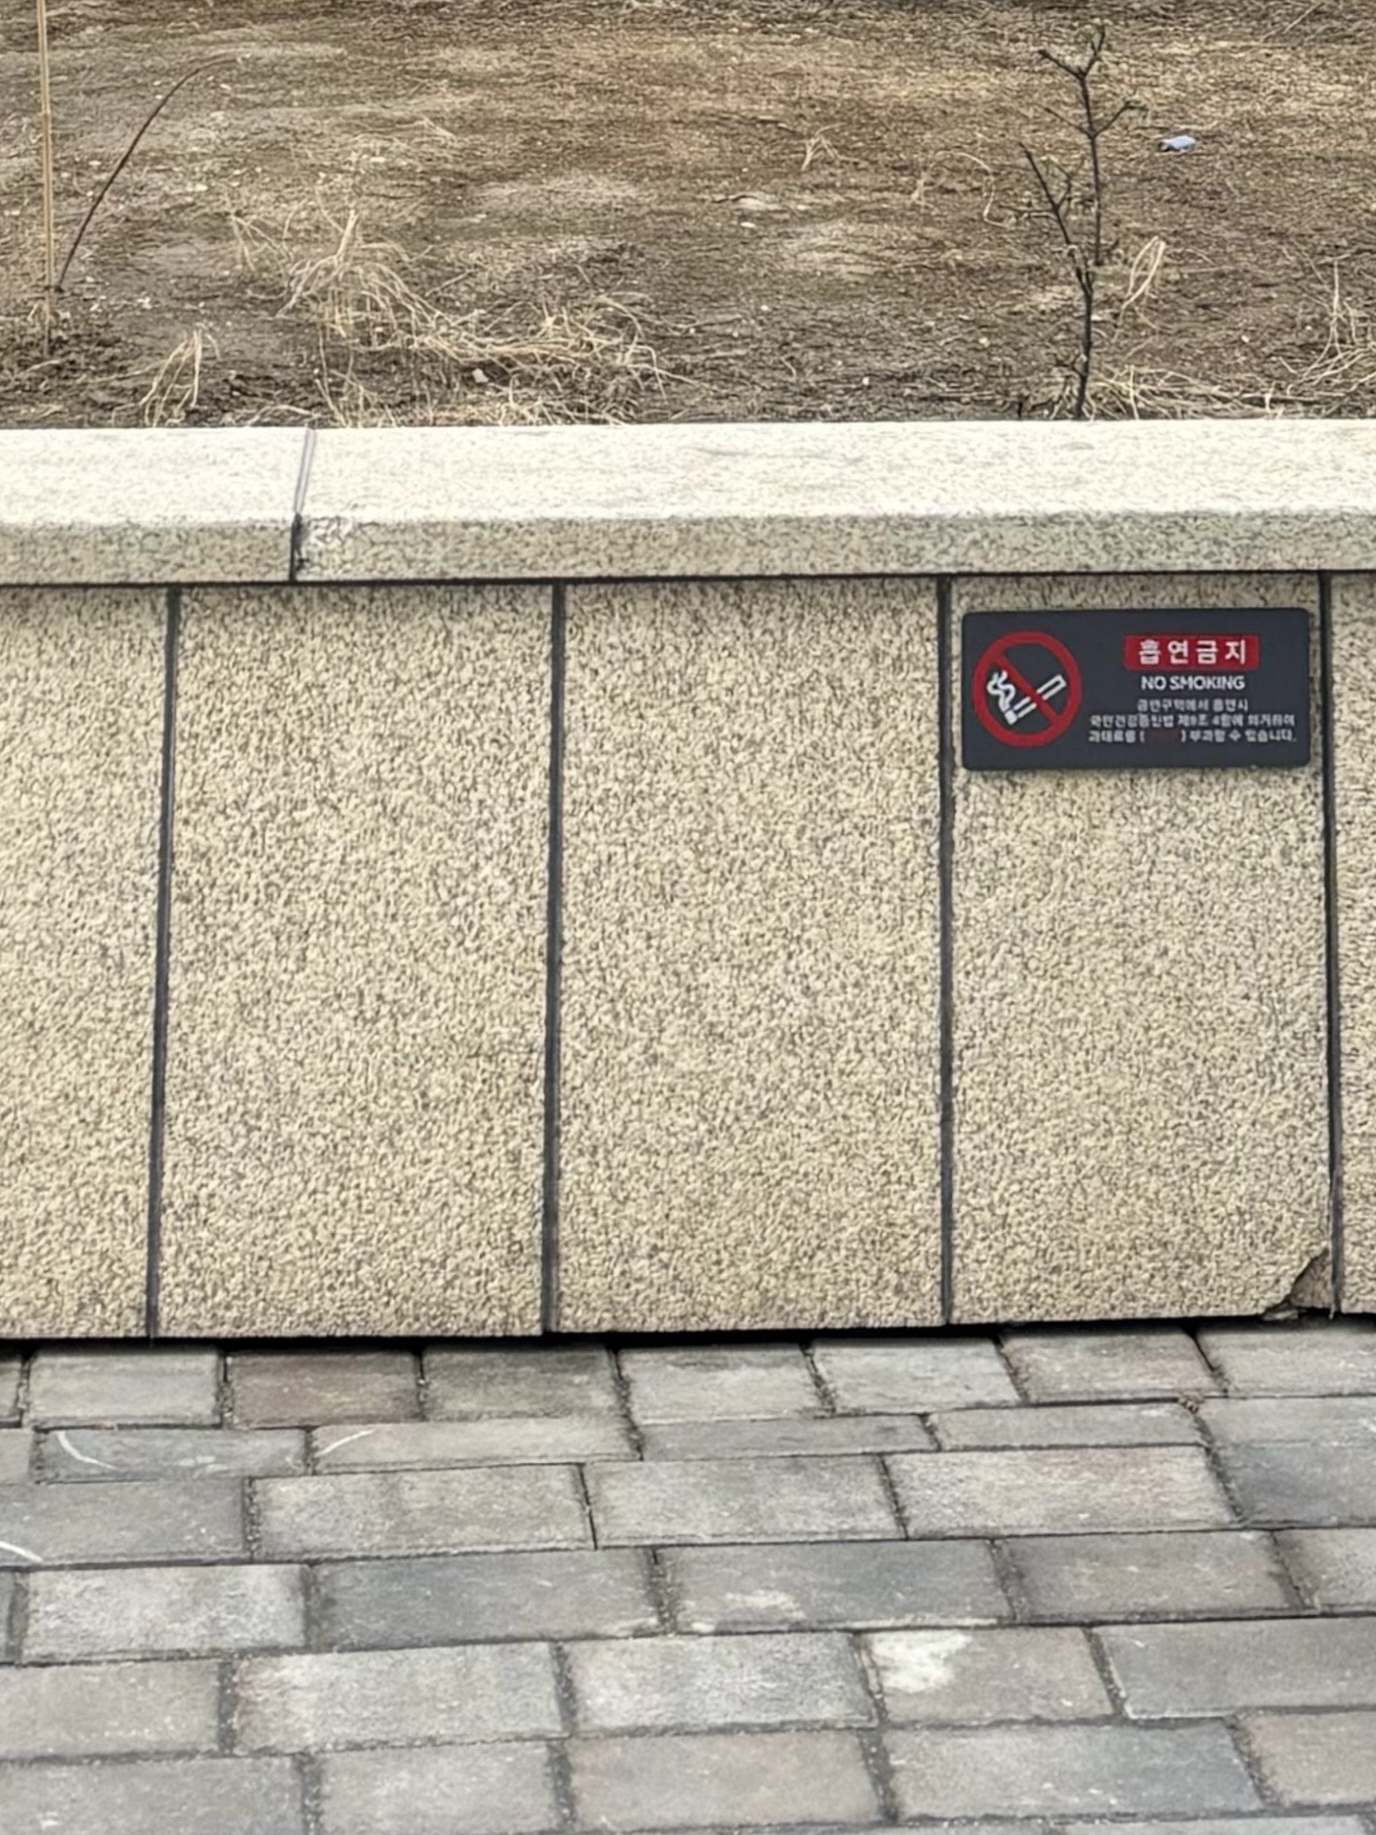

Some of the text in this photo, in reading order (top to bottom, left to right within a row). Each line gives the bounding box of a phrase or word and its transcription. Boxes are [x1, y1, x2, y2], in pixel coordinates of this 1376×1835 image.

[1139, 639, 1246, 664] 흡연금지
[1141, 675, 1246, 691] NO SMOKING
